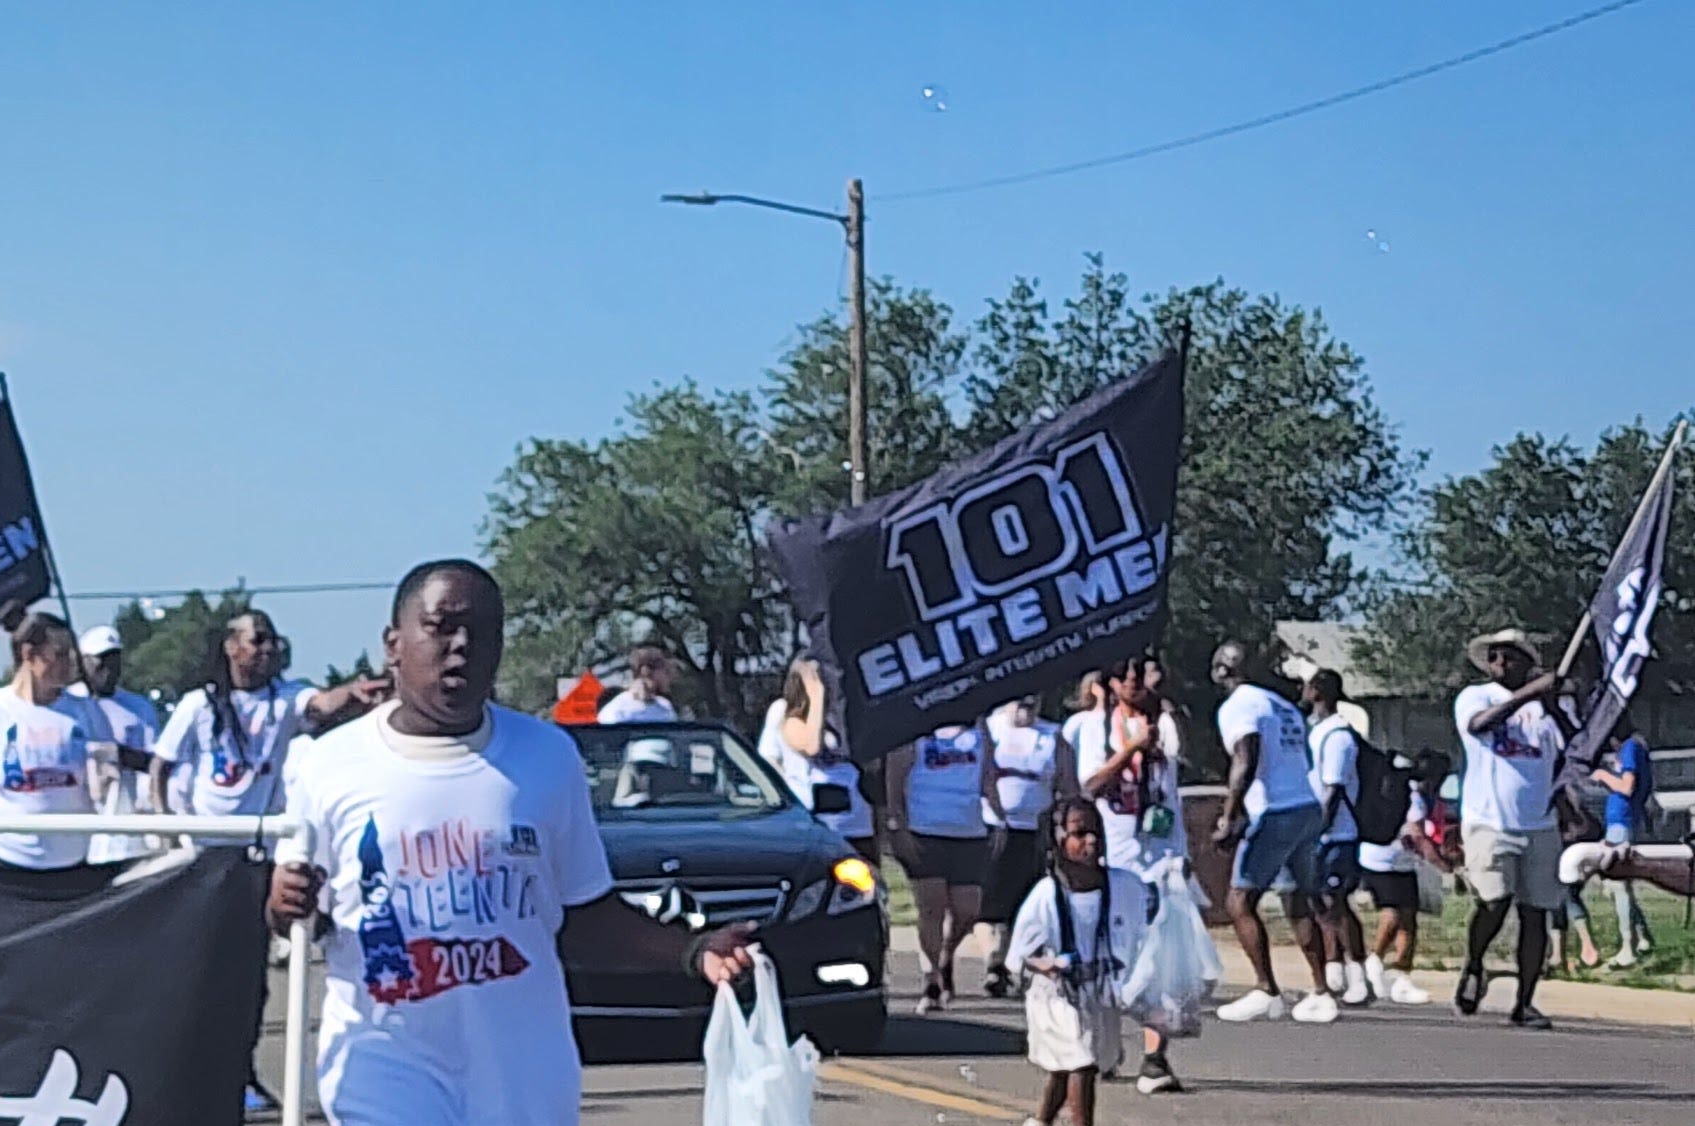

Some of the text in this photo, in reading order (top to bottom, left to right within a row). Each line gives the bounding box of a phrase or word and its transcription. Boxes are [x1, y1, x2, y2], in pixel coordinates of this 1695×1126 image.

[887, 432, 1142, 621] 101
[858, 588, 1048, 697] ELITE
[431, 939, 503, 986] 2024
